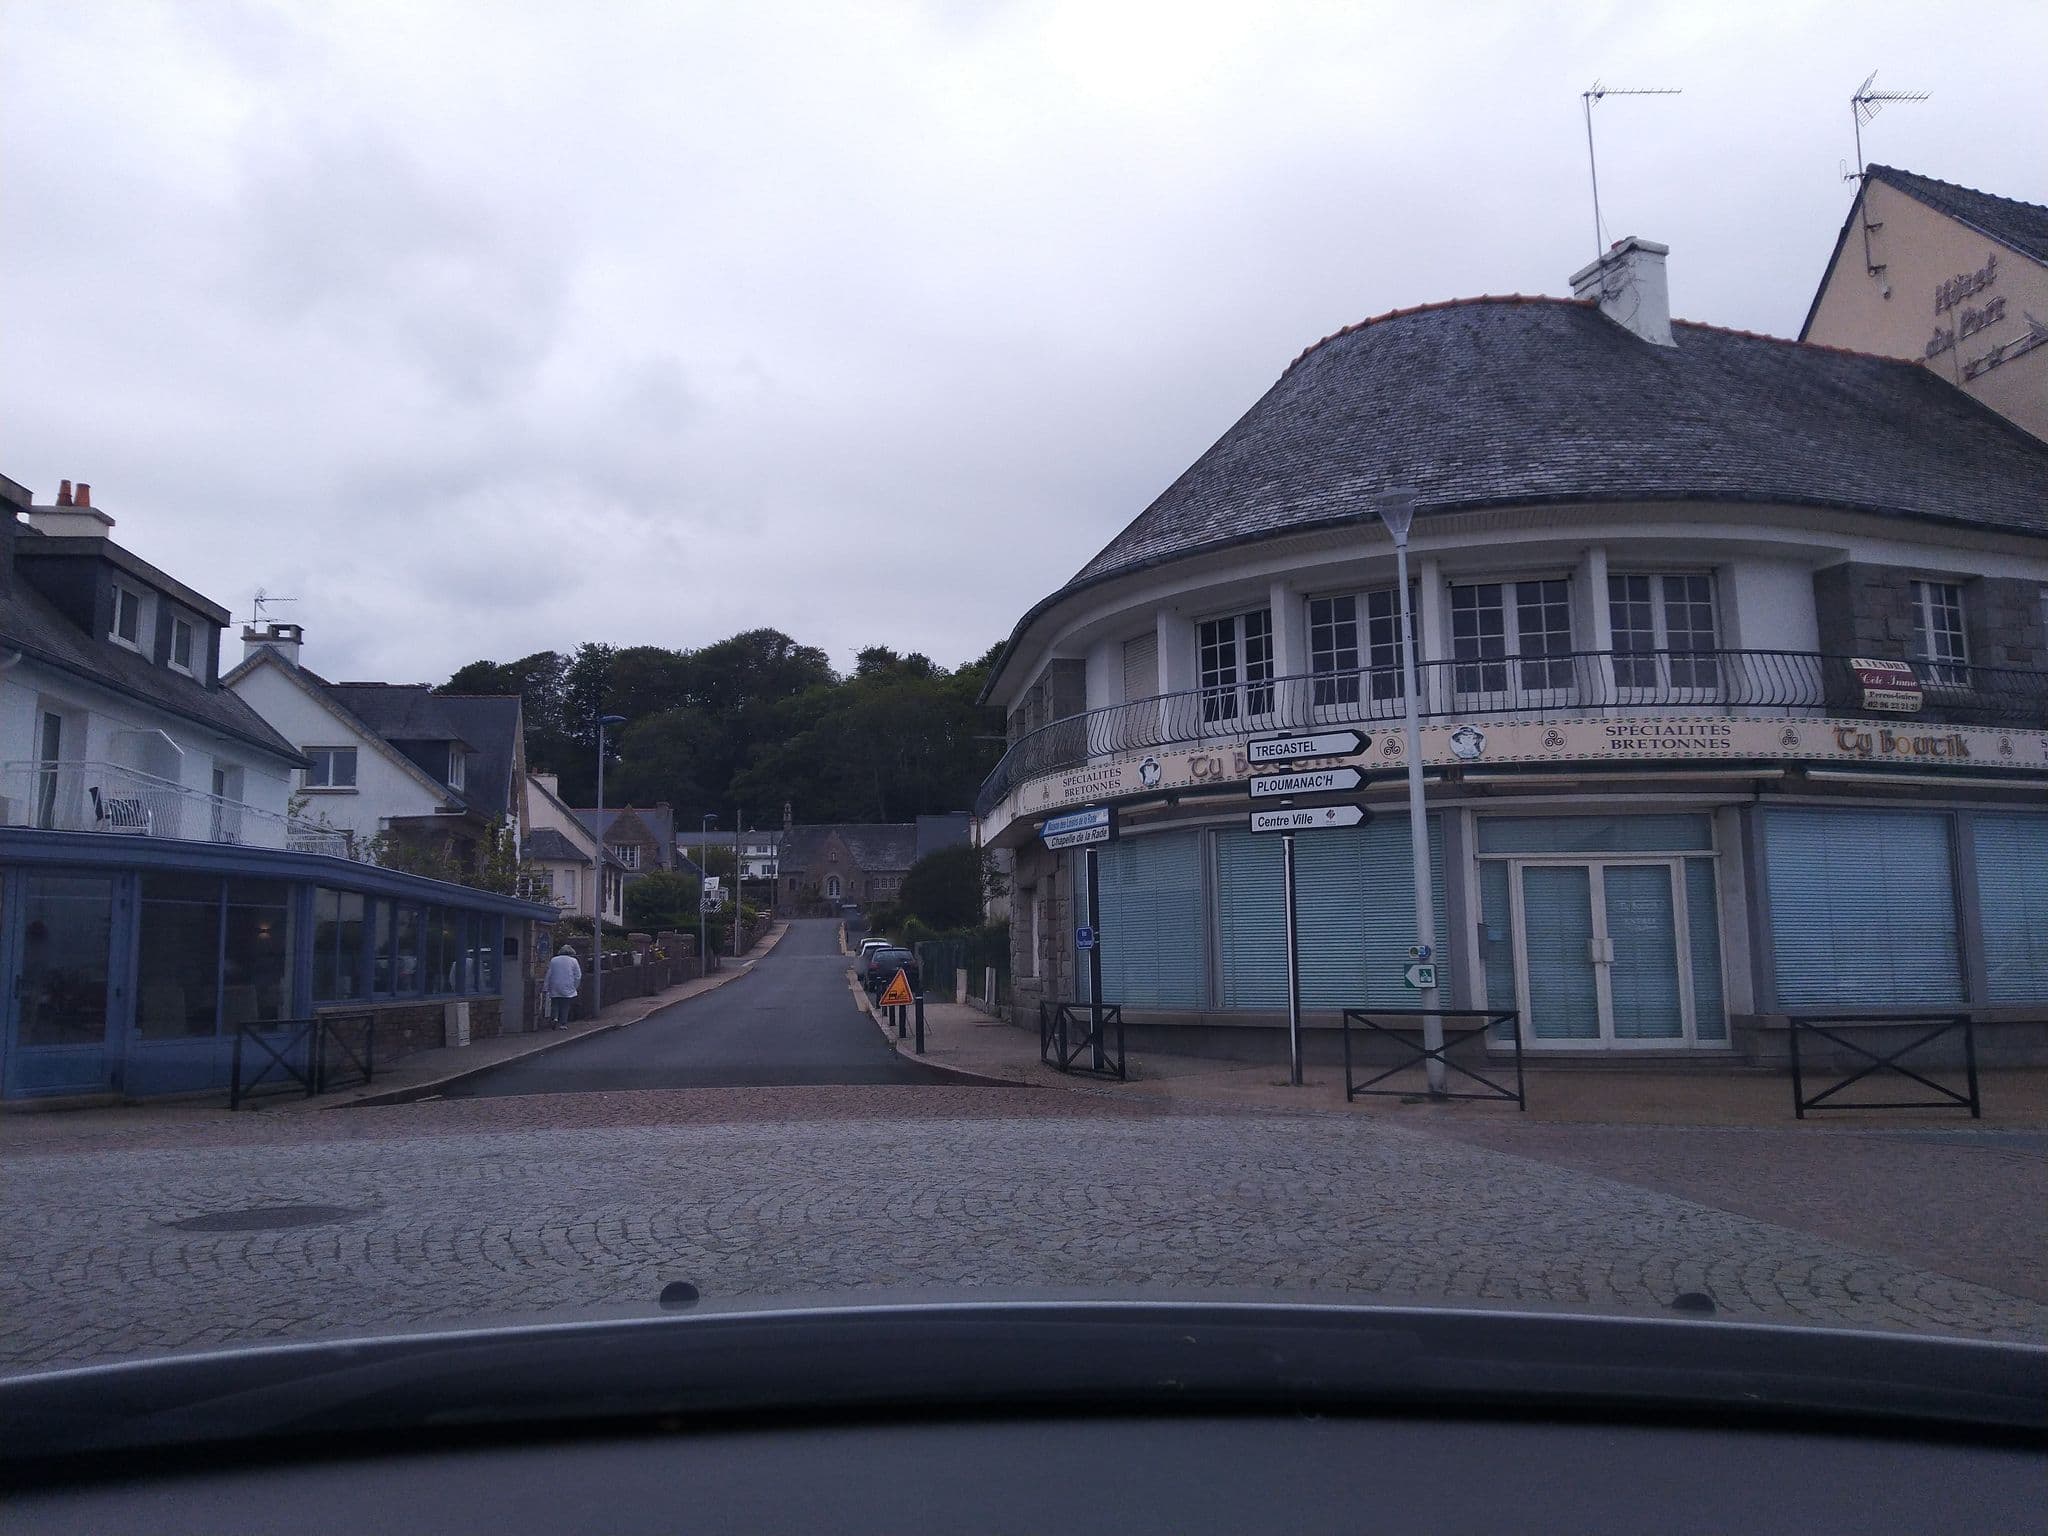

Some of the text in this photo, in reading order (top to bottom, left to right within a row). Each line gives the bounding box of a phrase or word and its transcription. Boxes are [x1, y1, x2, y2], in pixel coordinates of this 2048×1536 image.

[1255, 741, 1317, 757] TREGASTEL
[1611, 739, 1731, 749] BRETONNES
[1064, 779, 1121, 797] BRETONNES
[1256, 774, 1334, 793] PLOUMANAC'H
[1257, 815, 1289, 828] Centre
[1292, 813, 1313, 825] Ville
[1051, 828, 1107, 847] Chapelle de la Rade
